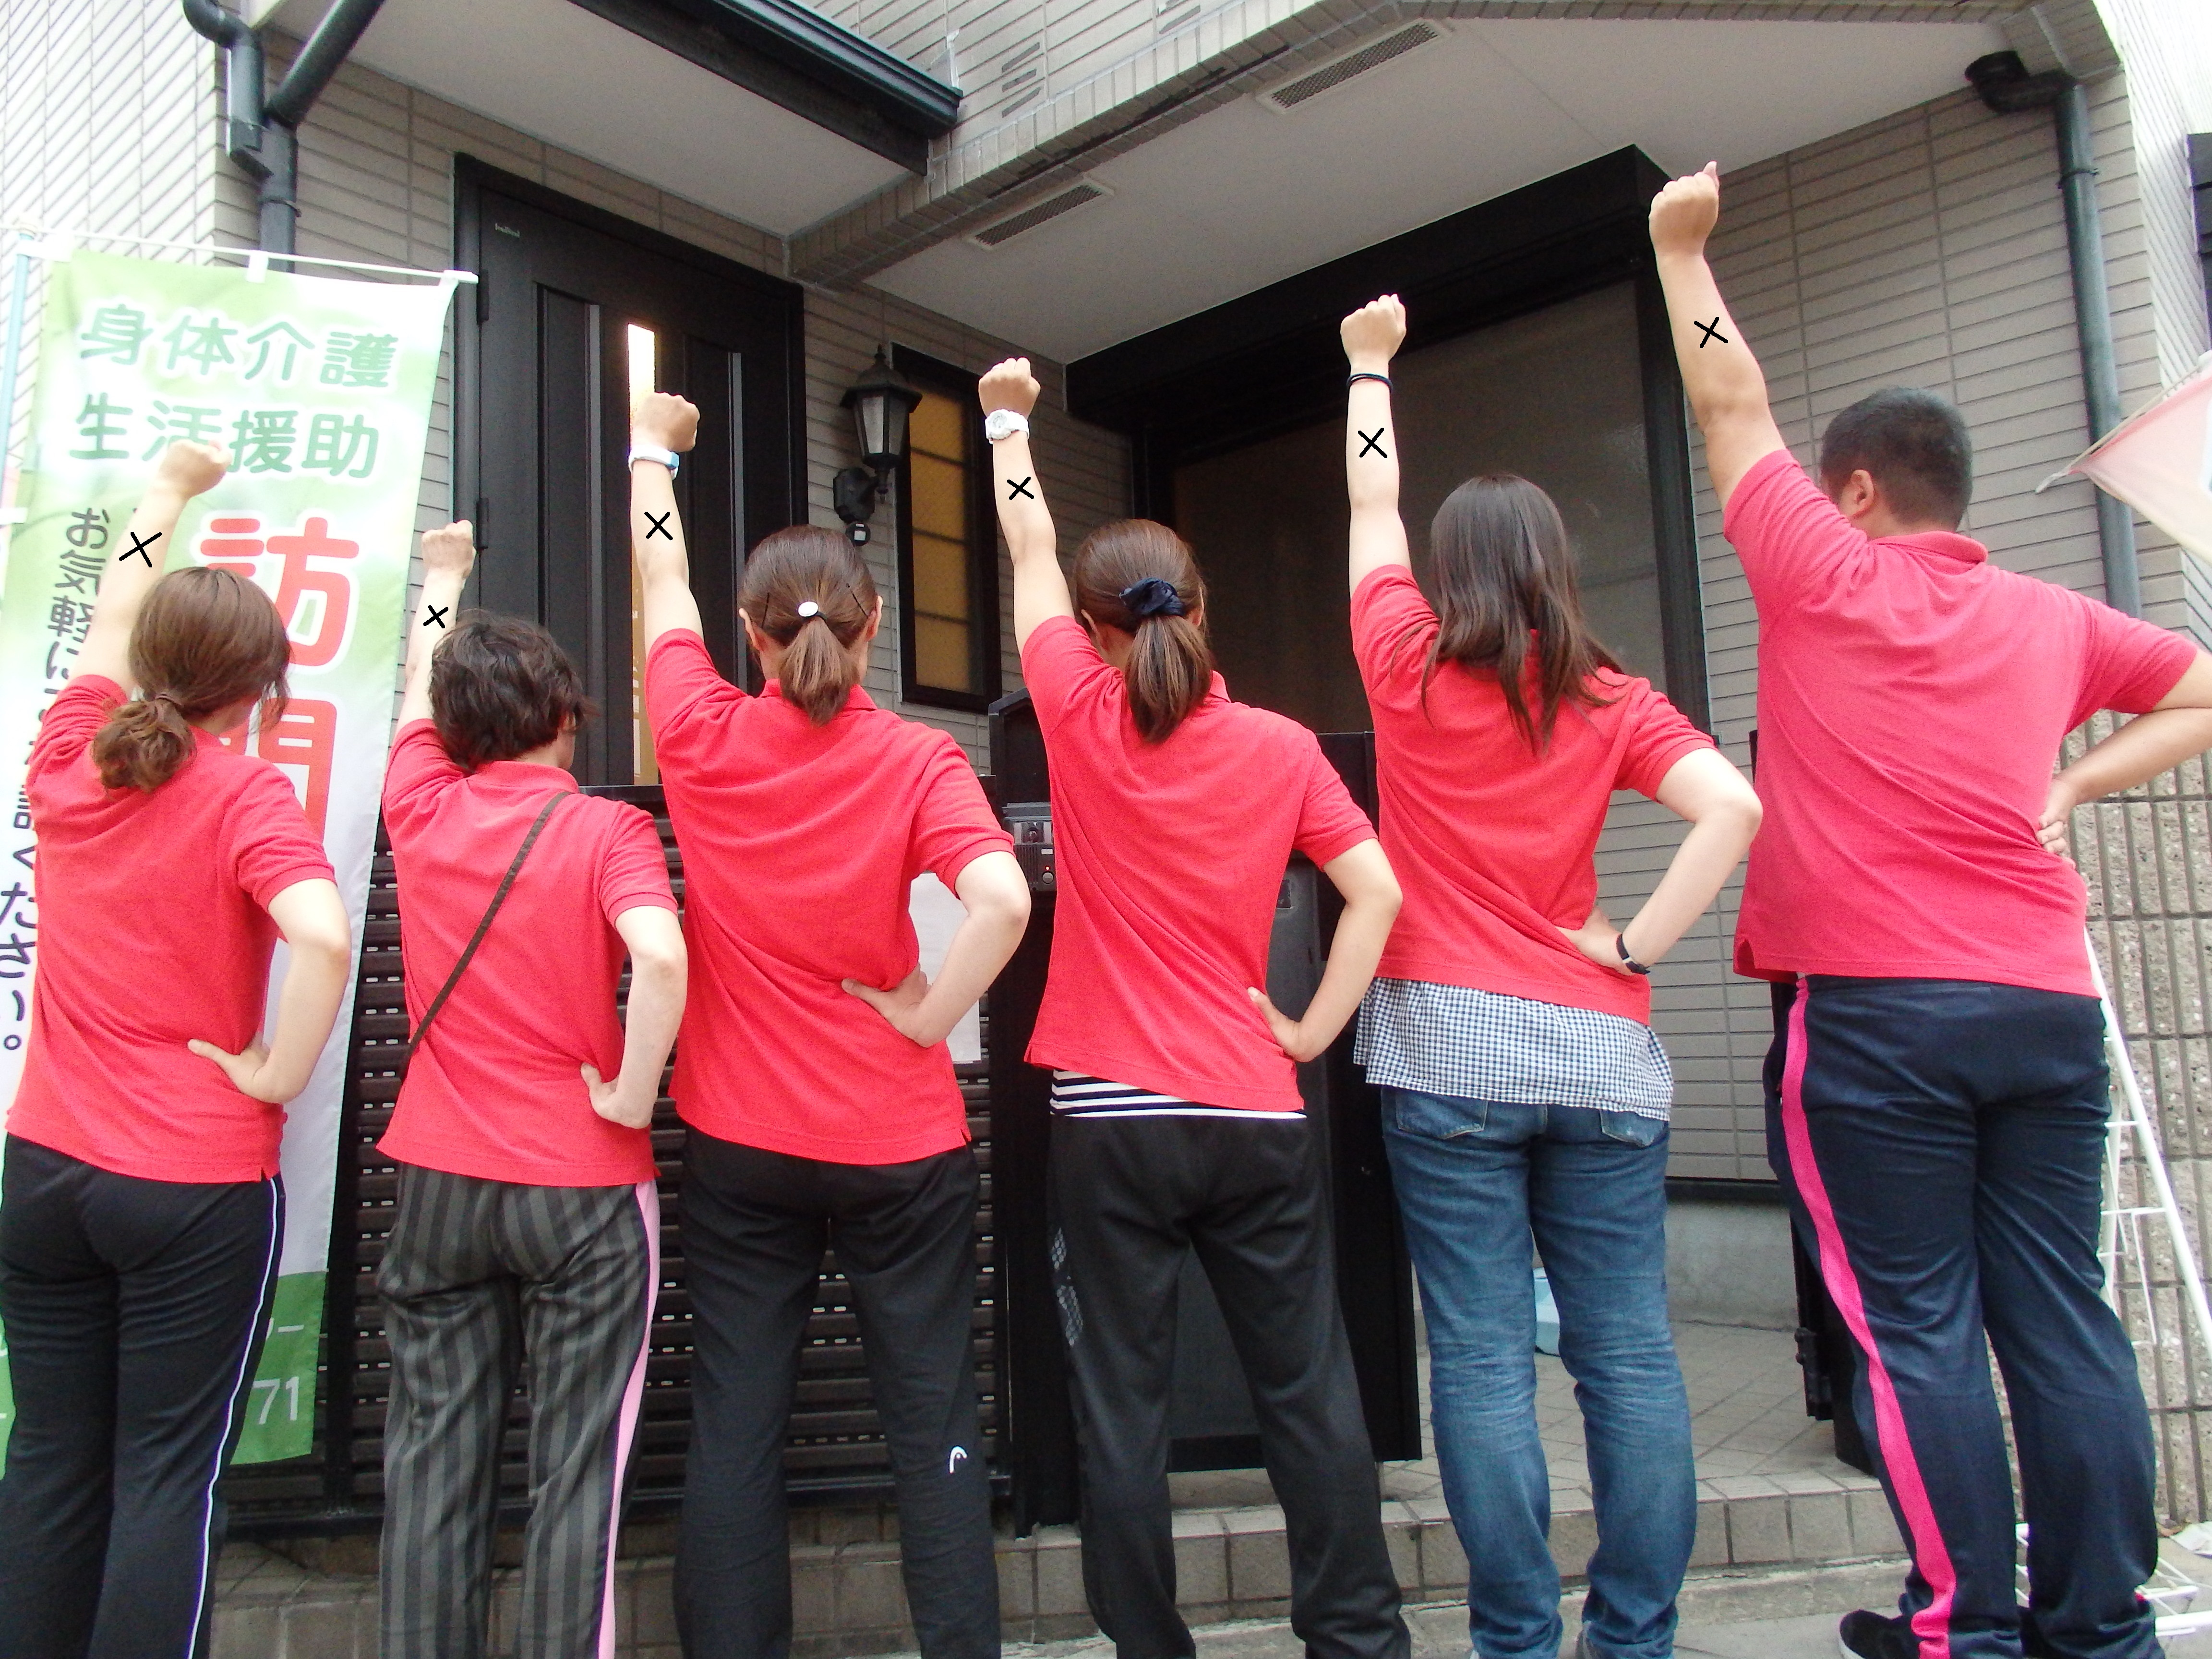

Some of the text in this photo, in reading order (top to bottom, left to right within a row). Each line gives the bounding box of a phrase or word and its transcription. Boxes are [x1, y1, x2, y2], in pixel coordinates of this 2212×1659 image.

[81, 303, 398, 387] 身体介護
[71, 393, 380, 478] 生活援助
